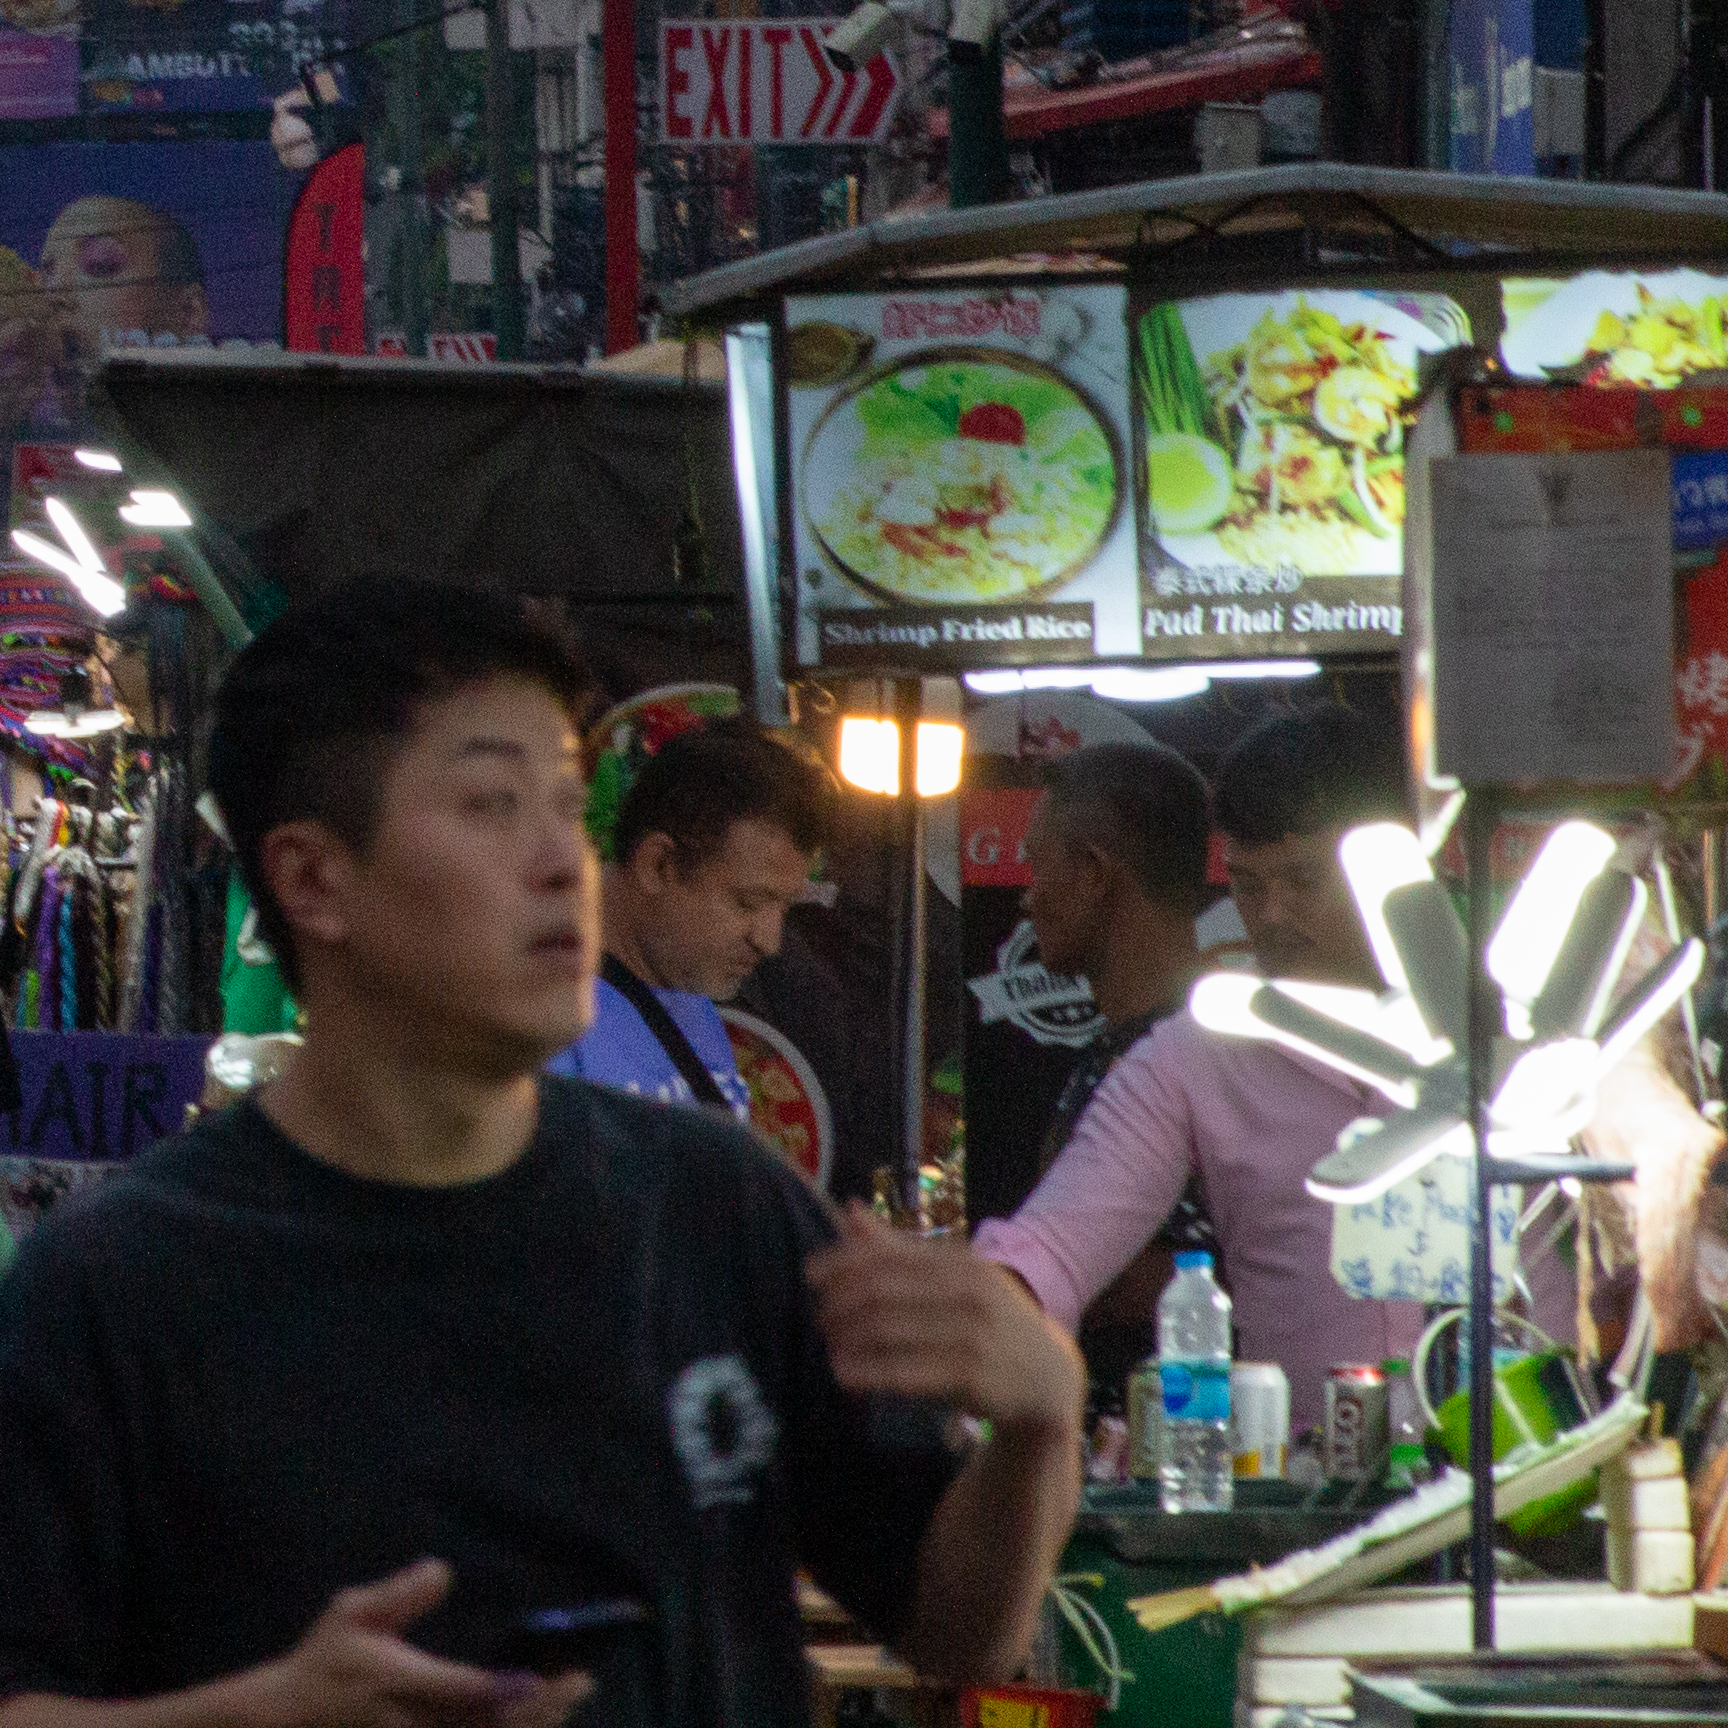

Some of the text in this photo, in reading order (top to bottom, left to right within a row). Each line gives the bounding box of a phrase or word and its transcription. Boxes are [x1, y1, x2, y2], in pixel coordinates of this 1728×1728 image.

[667, 28, 793, 139] EXIT
[825, 614, 1092, 650] Shrimp Fried Rice
[1144, 603, 1204, 638] Pad
[1210, 601, 1285, 635] Thai
